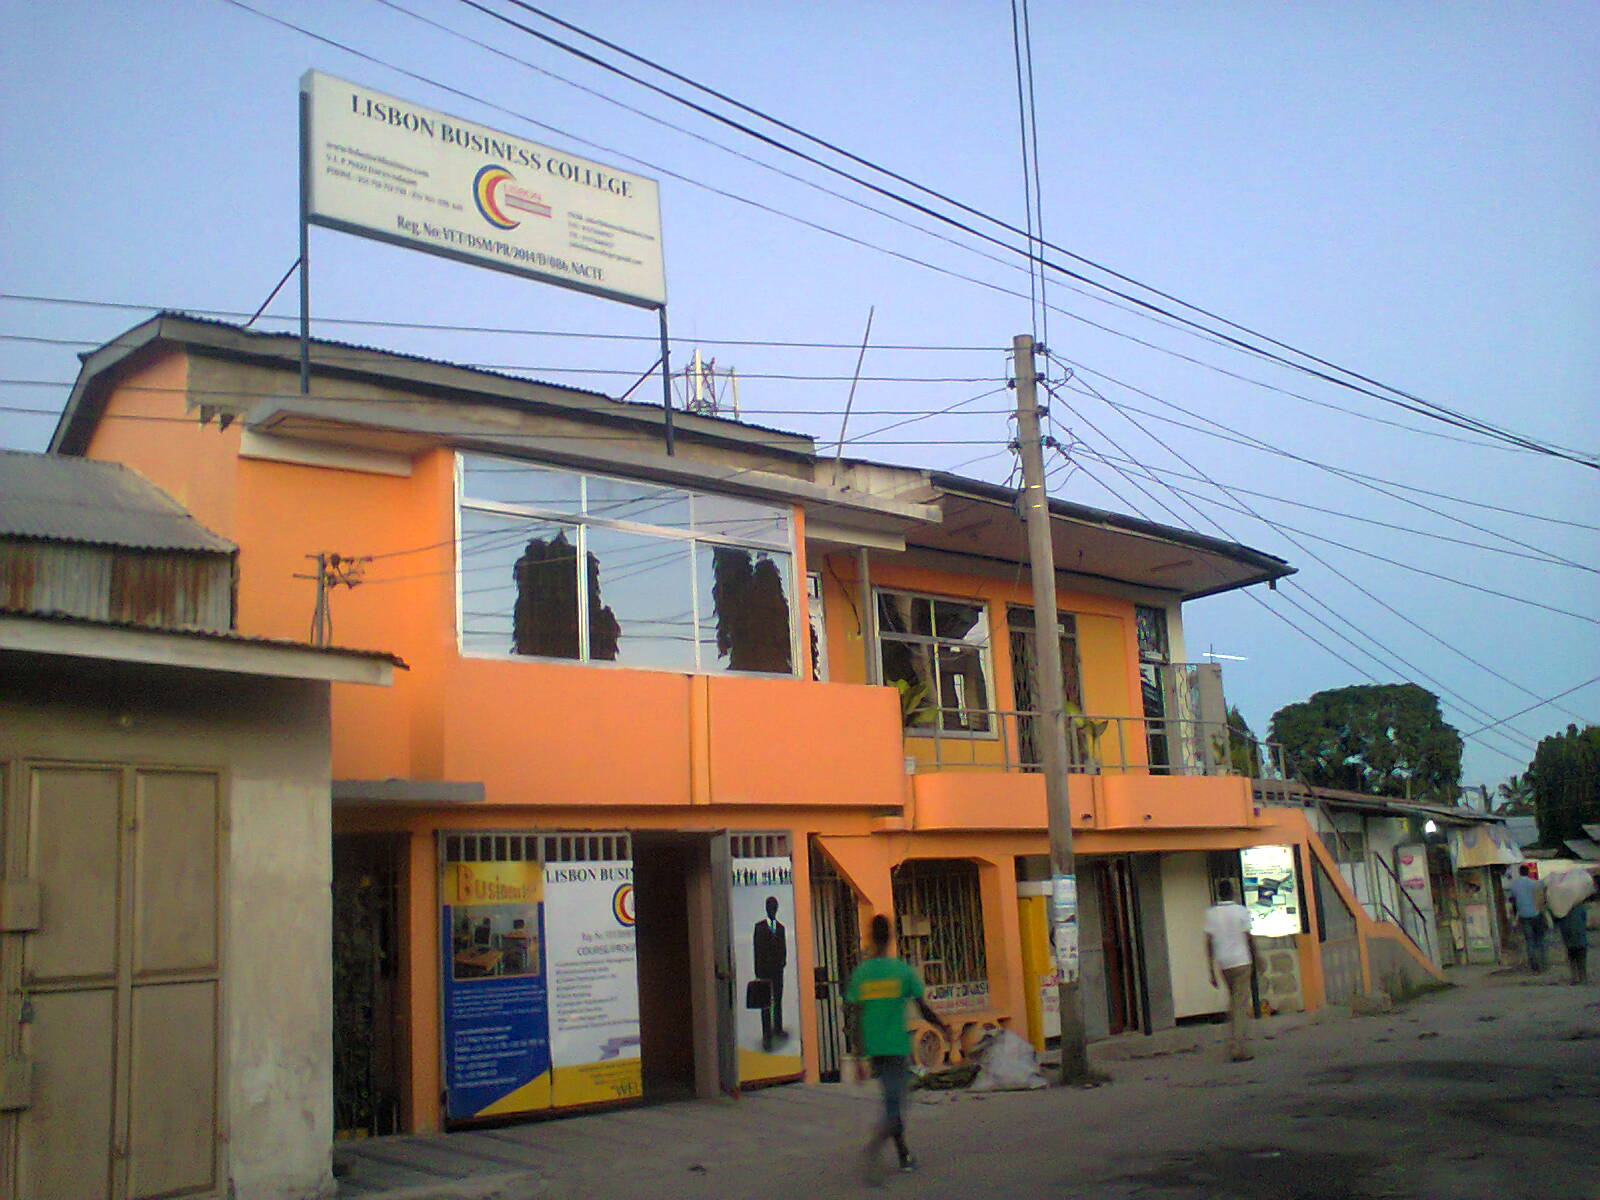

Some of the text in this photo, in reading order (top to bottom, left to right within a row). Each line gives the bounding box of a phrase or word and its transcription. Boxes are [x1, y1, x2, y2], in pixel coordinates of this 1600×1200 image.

[352, 94, 434, 138] LISBON
[441, 123, 541, 170] BUSINESS
[547, 158, 633, 198] COLLEGE
[546, 867, 635, 884] LISBON BUSI
